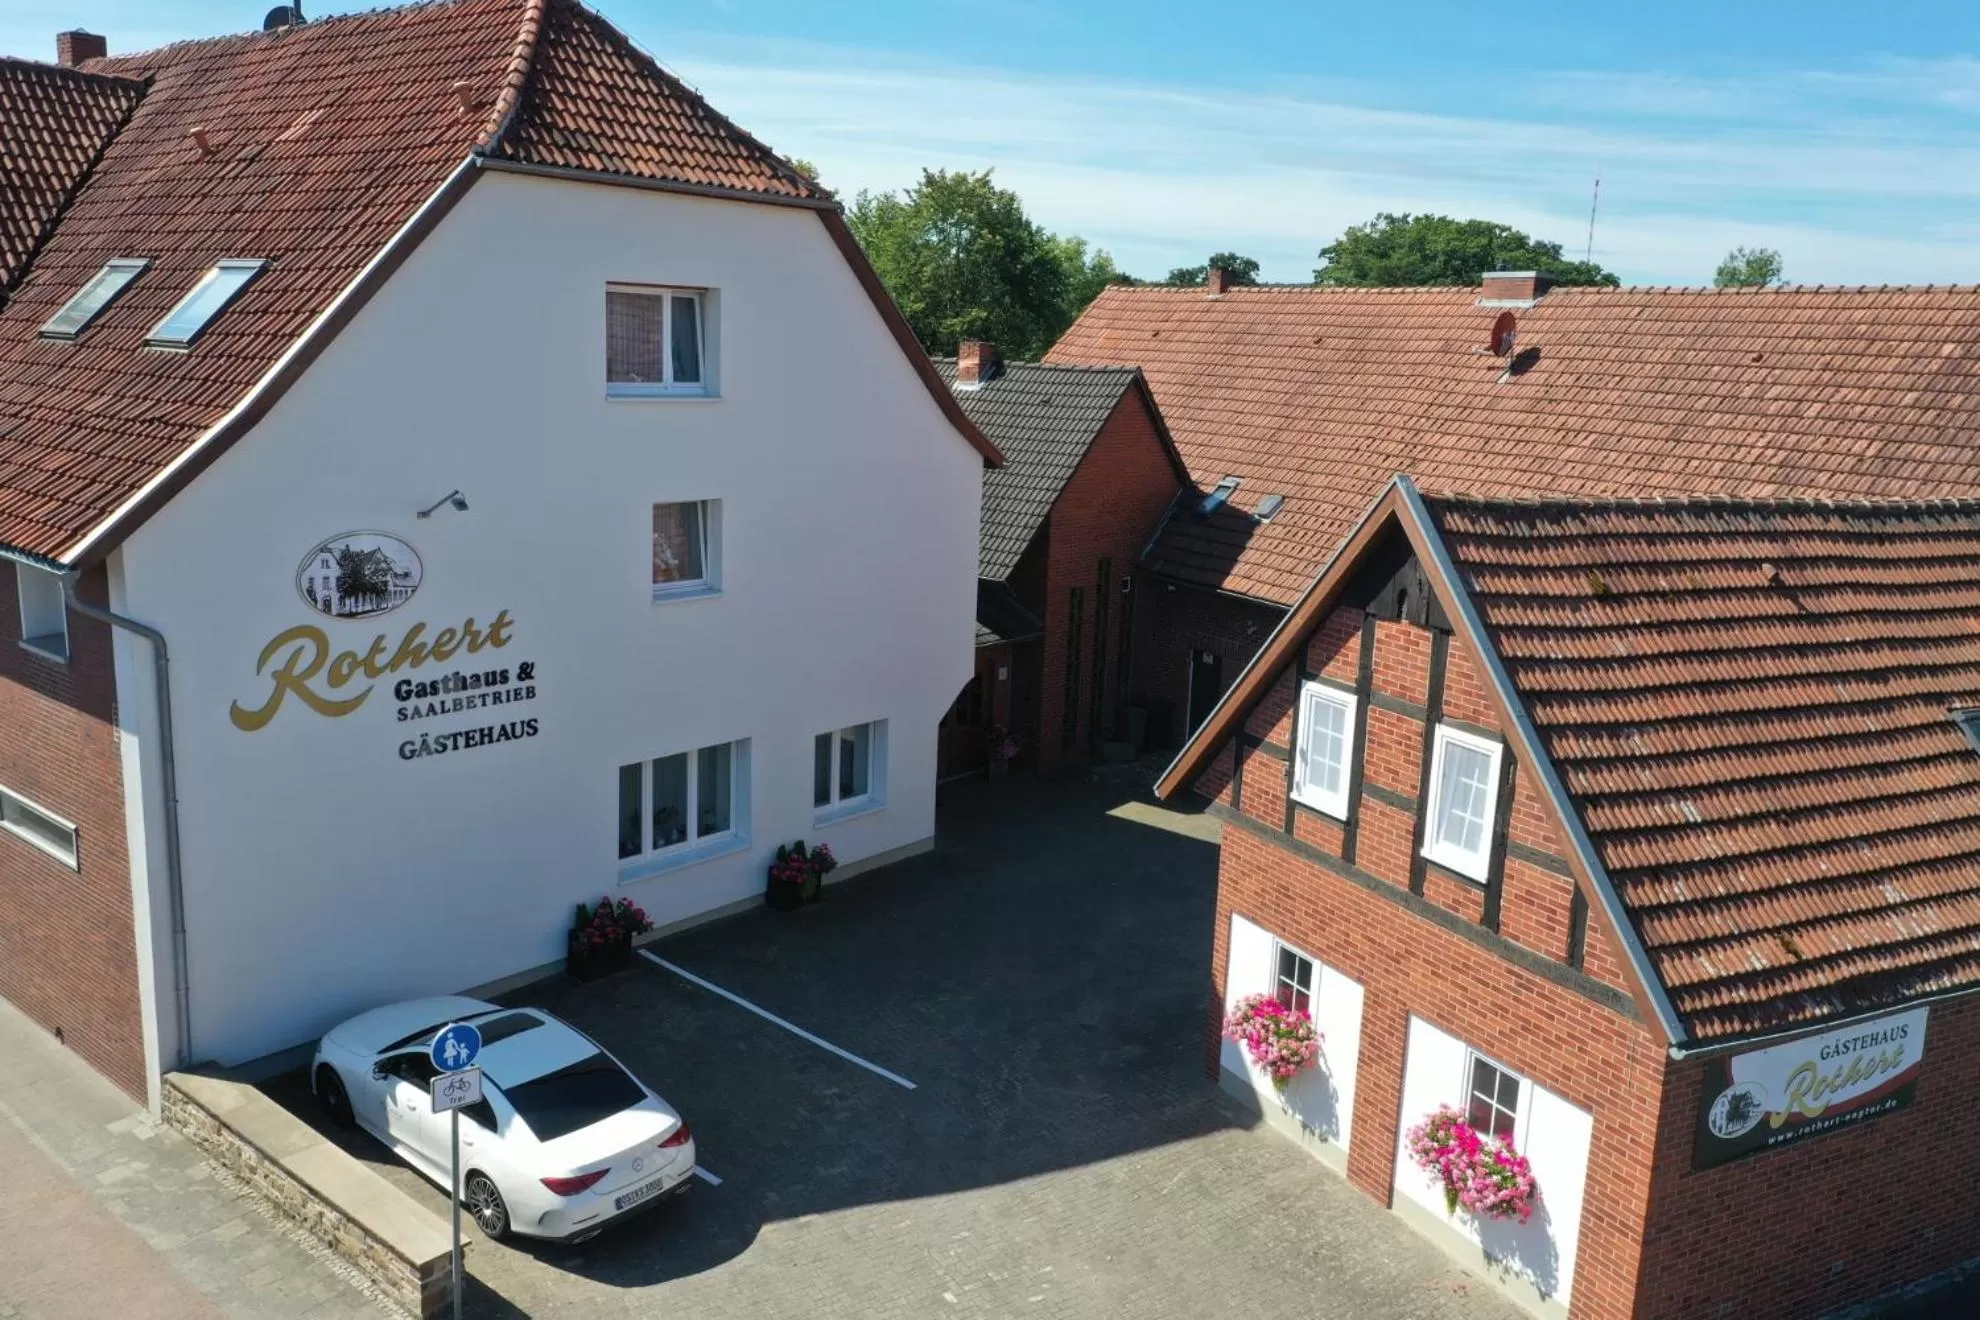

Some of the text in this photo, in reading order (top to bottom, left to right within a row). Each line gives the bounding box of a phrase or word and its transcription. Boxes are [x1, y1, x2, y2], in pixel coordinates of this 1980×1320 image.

[230, 609, 514, 732] Rothert
[394, 661, 536, 702] Gasthaus &
[397, 686, 537, 722] SAALBETRIEB
[399, 718, 539, 761] GÄSTEHAUS
[1819, 1023, 1909, 1061] GÄSTEHAUS
[1769, 1044, 1905, 1129] Rothert
